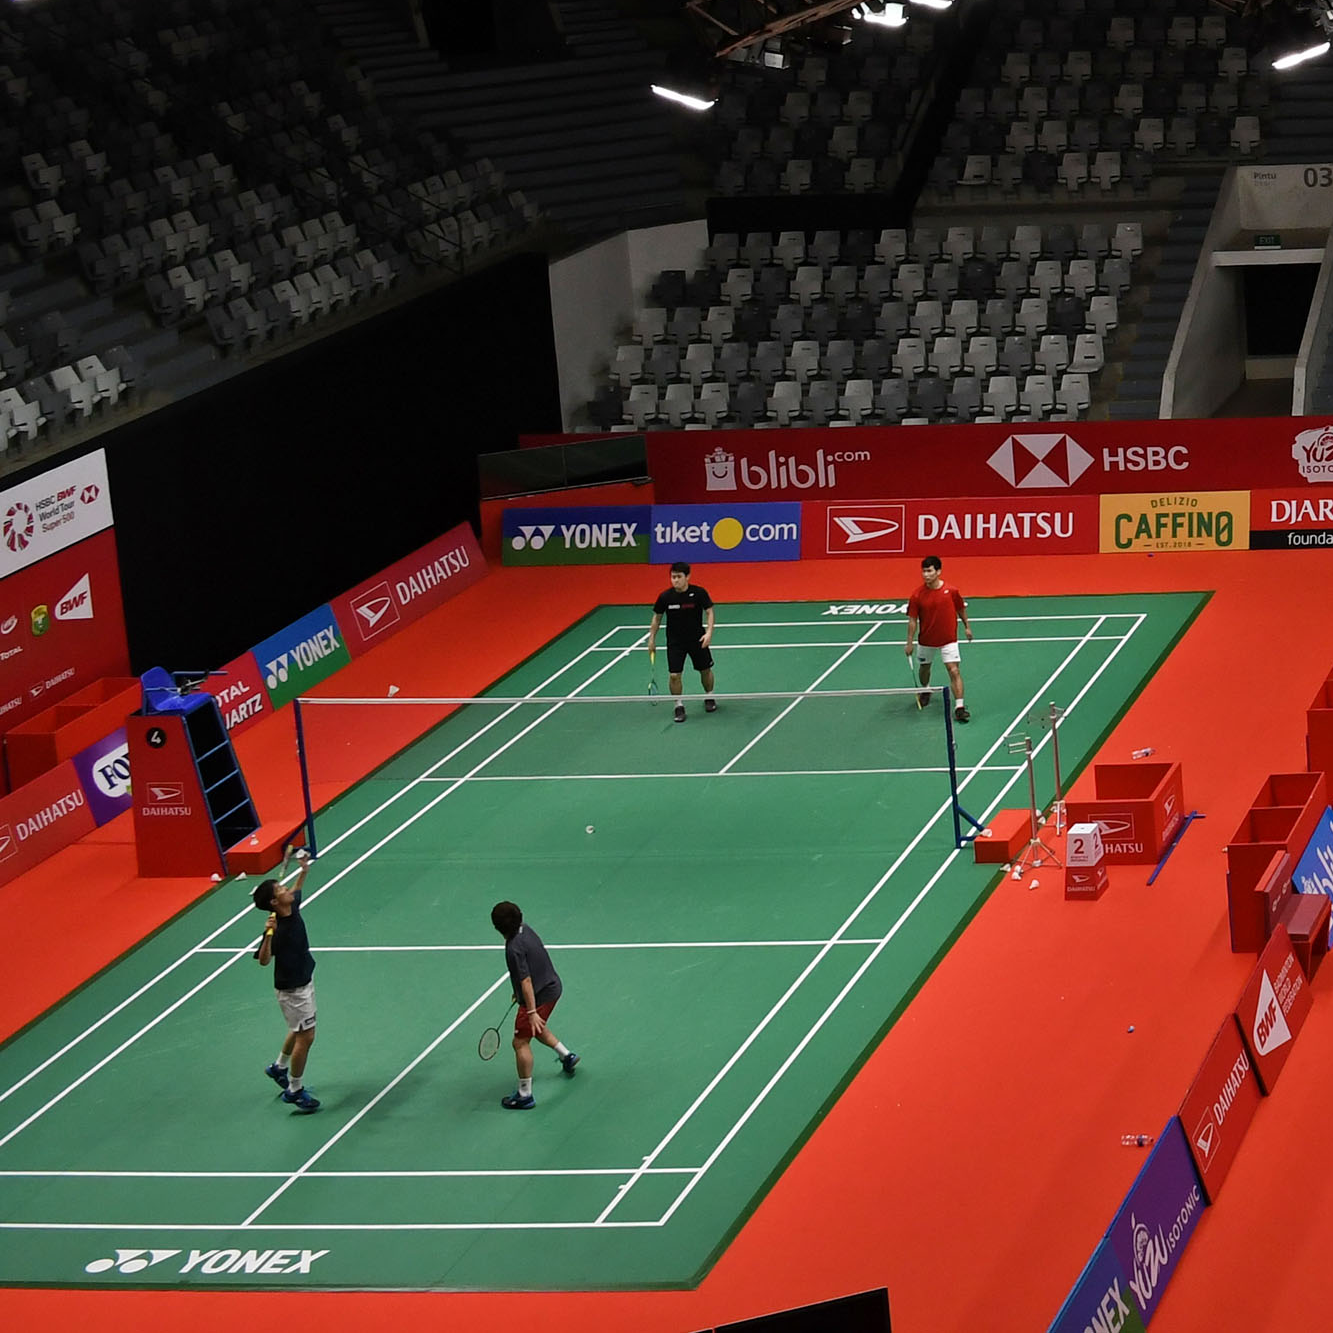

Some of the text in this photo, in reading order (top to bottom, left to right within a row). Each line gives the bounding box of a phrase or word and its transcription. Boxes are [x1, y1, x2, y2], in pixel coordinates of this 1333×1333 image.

[1303, 167, 1333, 187] 03
[1103, 446, 1189, 471] HSBC
[57, 485, 77, 503] BWF
[1150, 496, 1199, 508] DELIZIO
[560, 522, 638, 548] YONEX
[917, 510, 1074, 540] DAIHATSU
[1114, 510, 1234, 549] CAFFINO
[396, 545, 471, 607] DAIHATSU
[60, 591, 88, 616] BWF
[288, 623, 341, 673] YONEX
[215, 681, 250, 708] OTAL
[151, 731, 162, 745] 4
[16, 789, 85, 842] DAIHATSU
[142, 807, 192, 816] DAIHATSU
[1073, 838, 1085, 855] 2
[1104, 842, 1144, 855] HATSU
[1257, 998, 1278, 1049] BWF
[1213, 1049, 1250, 1126] DAIHATSU
[1166, 1185, 1201, 1253] ISOTONIC
[178, 1249, 331, 1274] YONEX
[1129, 1224, 1169, 1311] YUZU
